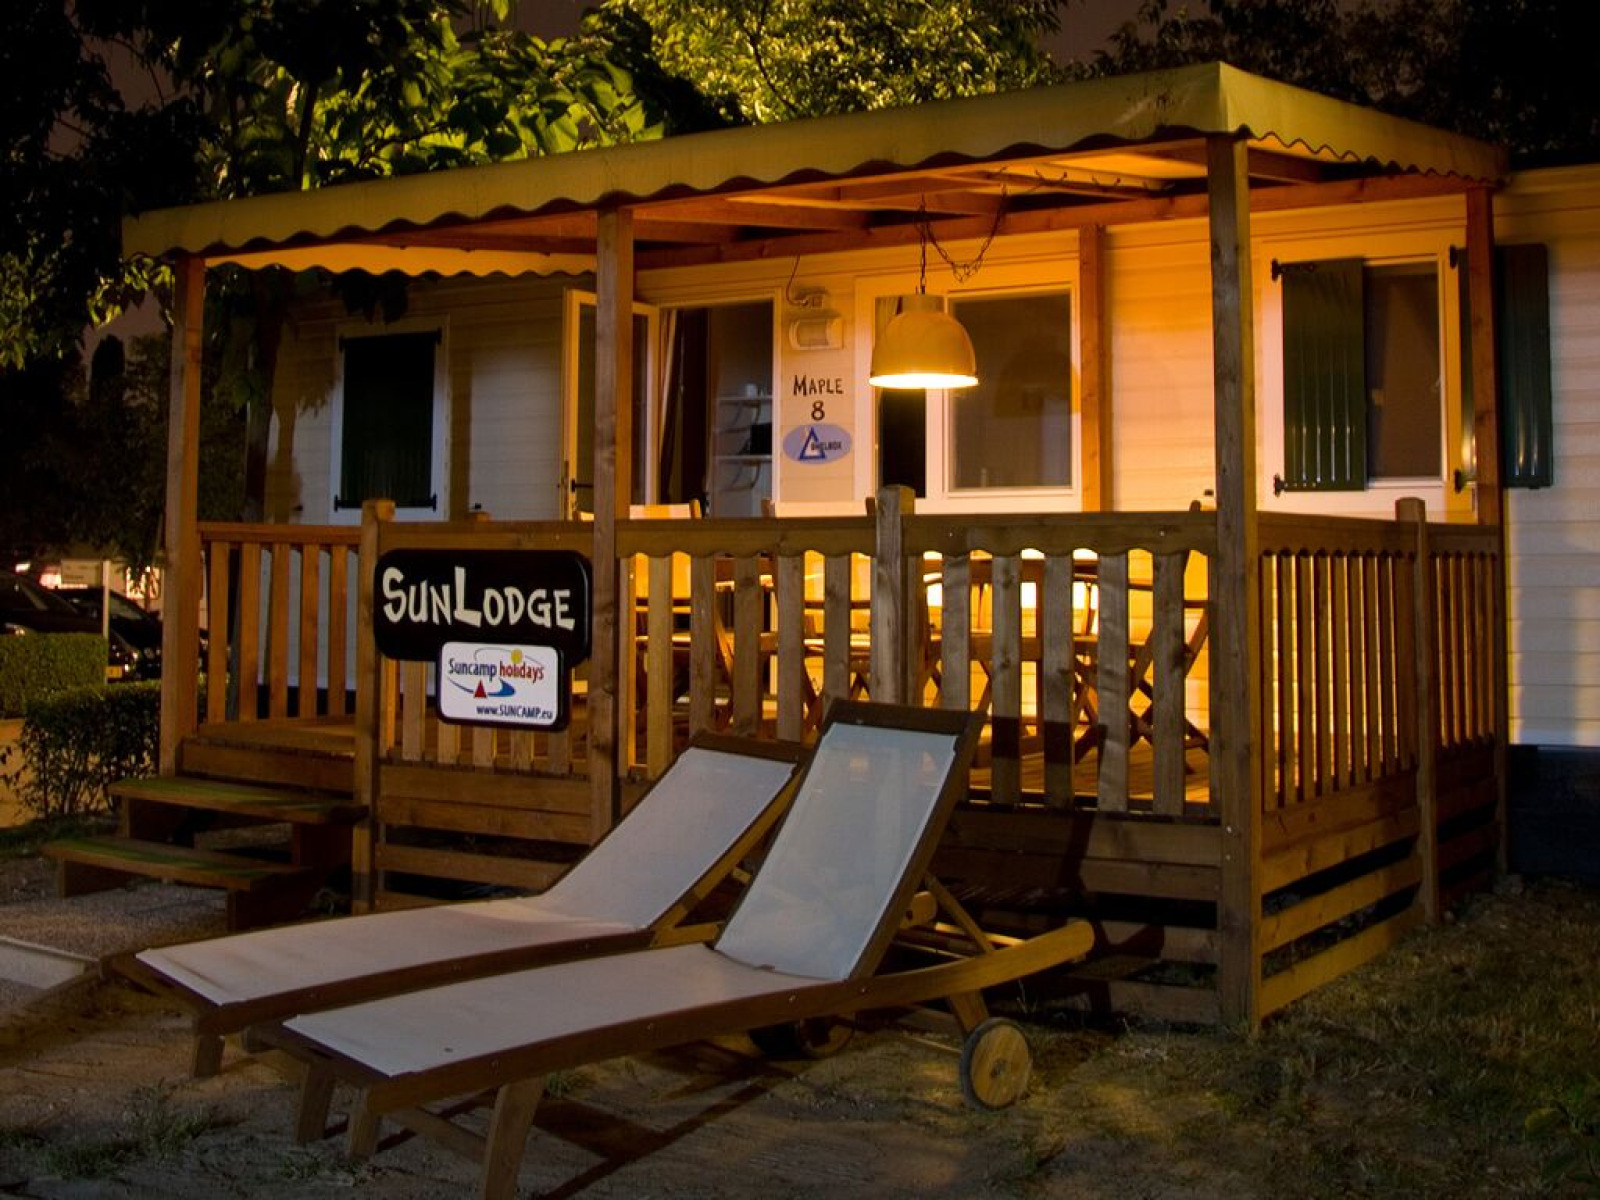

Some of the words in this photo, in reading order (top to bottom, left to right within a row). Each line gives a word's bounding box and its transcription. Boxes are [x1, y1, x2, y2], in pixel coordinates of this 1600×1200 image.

[793, 374, 844, 397] MAPLE
[811, 400, 826, 421] 8
[448, 658, 497, 682] Suncamp
[499, 660, 545, 684] holidays
[476, 704, 553, 720] www.SUNCAMP.eu
